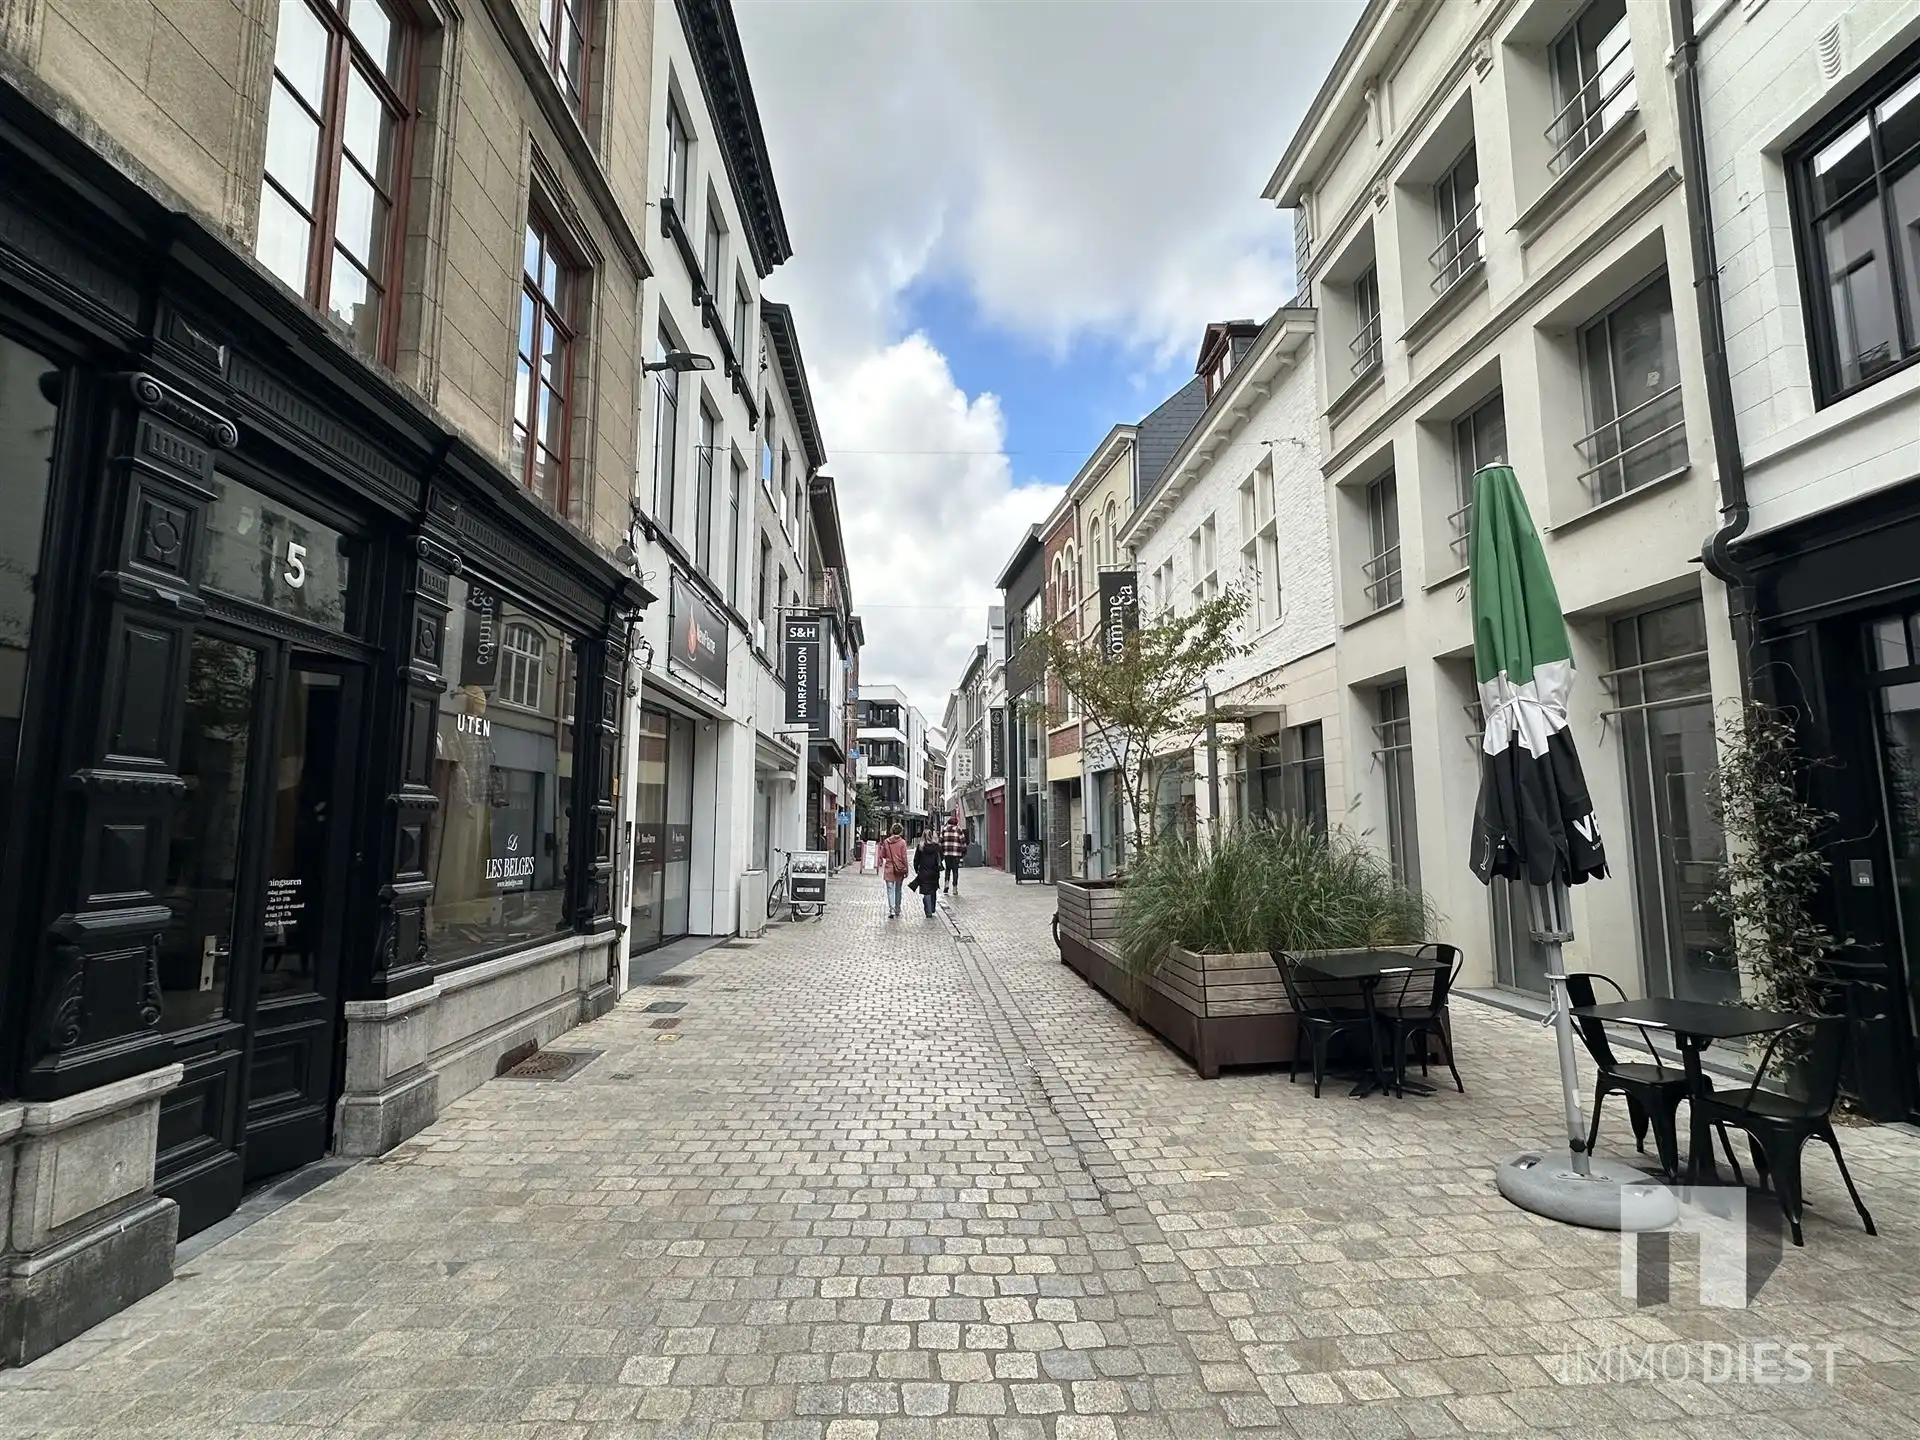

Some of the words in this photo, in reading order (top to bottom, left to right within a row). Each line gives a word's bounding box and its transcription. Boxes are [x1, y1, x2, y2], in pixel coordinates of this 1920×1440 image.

[284, 541, 306, 588] 5
[789, 627, 816, 638] S&H
[1110, 595, 1124, 663] comme
[1120, 584, 1137, 606] ça
[797, 646, 807, 718] HAIRFASHION
[456, 713, 491, 738] UTEN
[485, 858, 503, 880] LES
[504, 856, 535, 878] BELGES
